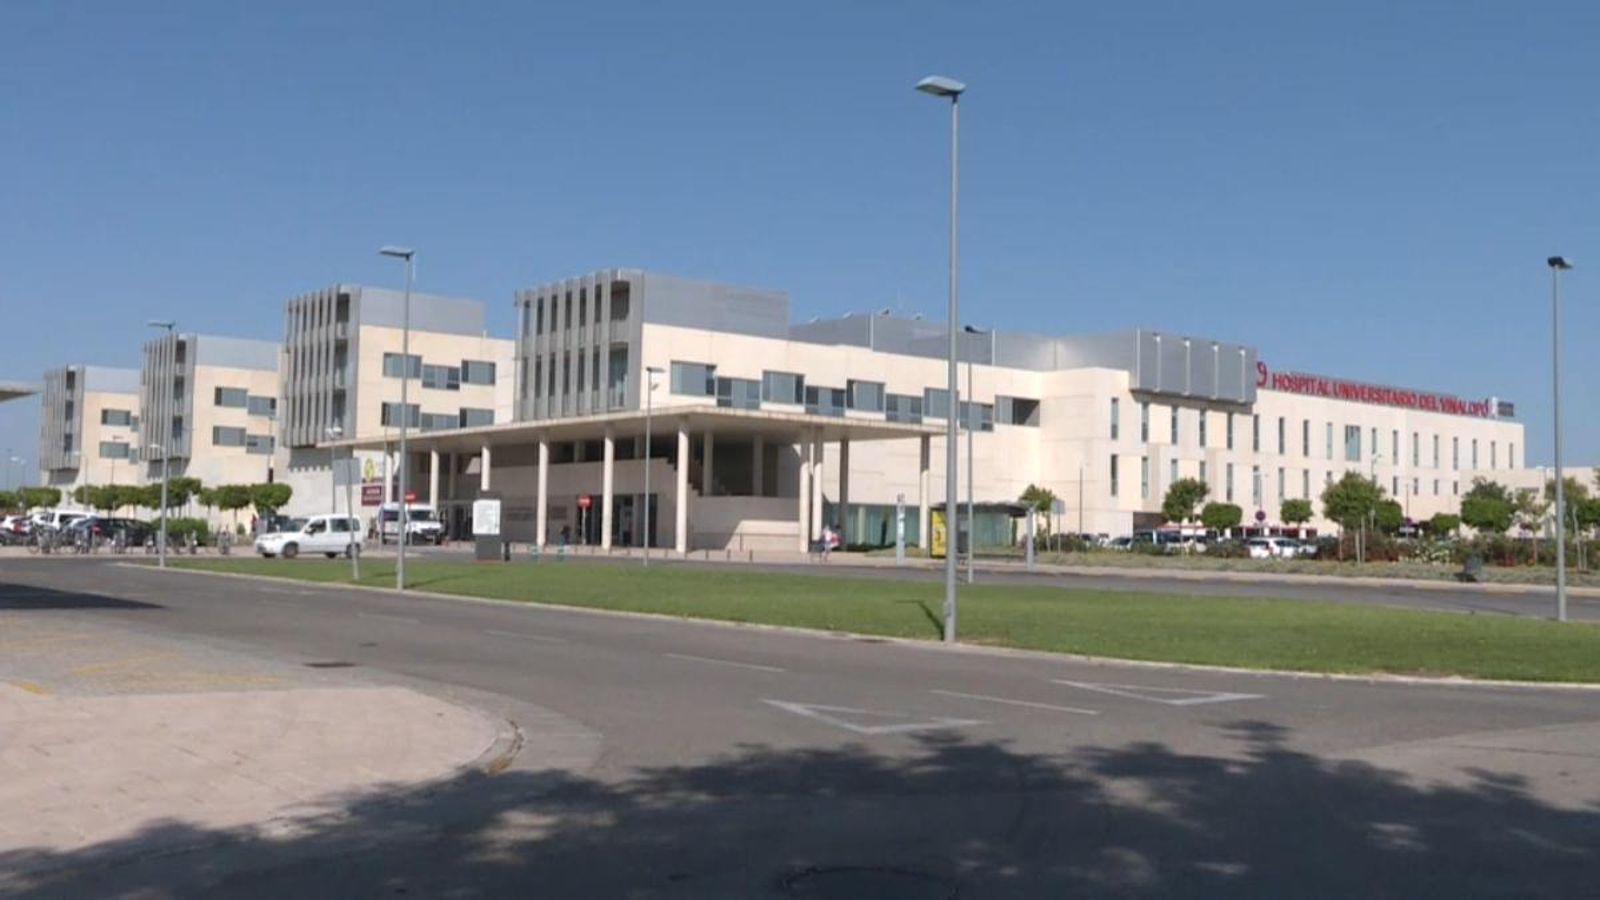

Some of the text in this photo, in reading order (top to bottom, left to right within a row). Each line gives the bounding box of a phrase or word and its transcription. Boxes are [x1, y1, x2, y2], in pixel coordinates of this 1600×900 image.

[1272, 373, 1329, 397] HOSPITAL
[1332, 380, 1417, 408] UNIVERSITARIO
[1419, 393, 1438, 411] DEL
